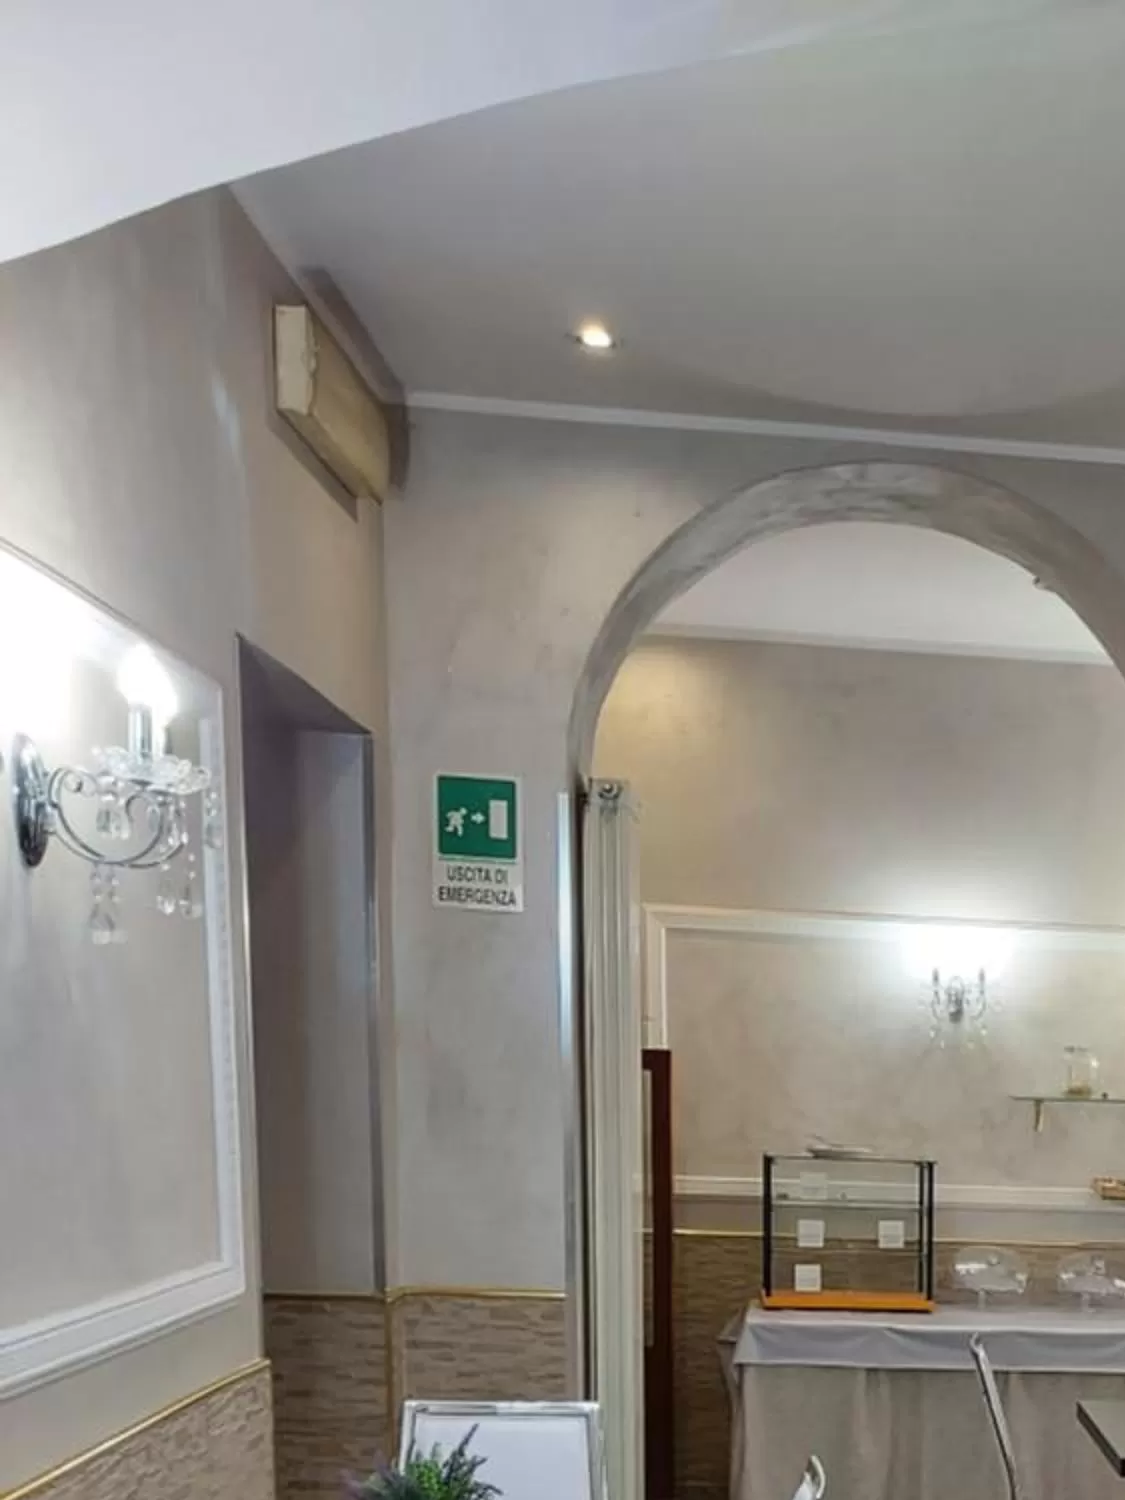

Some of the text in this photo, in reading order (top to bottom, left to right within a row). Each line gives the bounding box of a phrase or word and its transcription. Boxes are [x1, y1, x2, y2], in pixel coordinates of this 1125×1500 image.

[447, 865, 508, 884] USCITA DI
[438, 886, 516, 906] EMERGENZA
